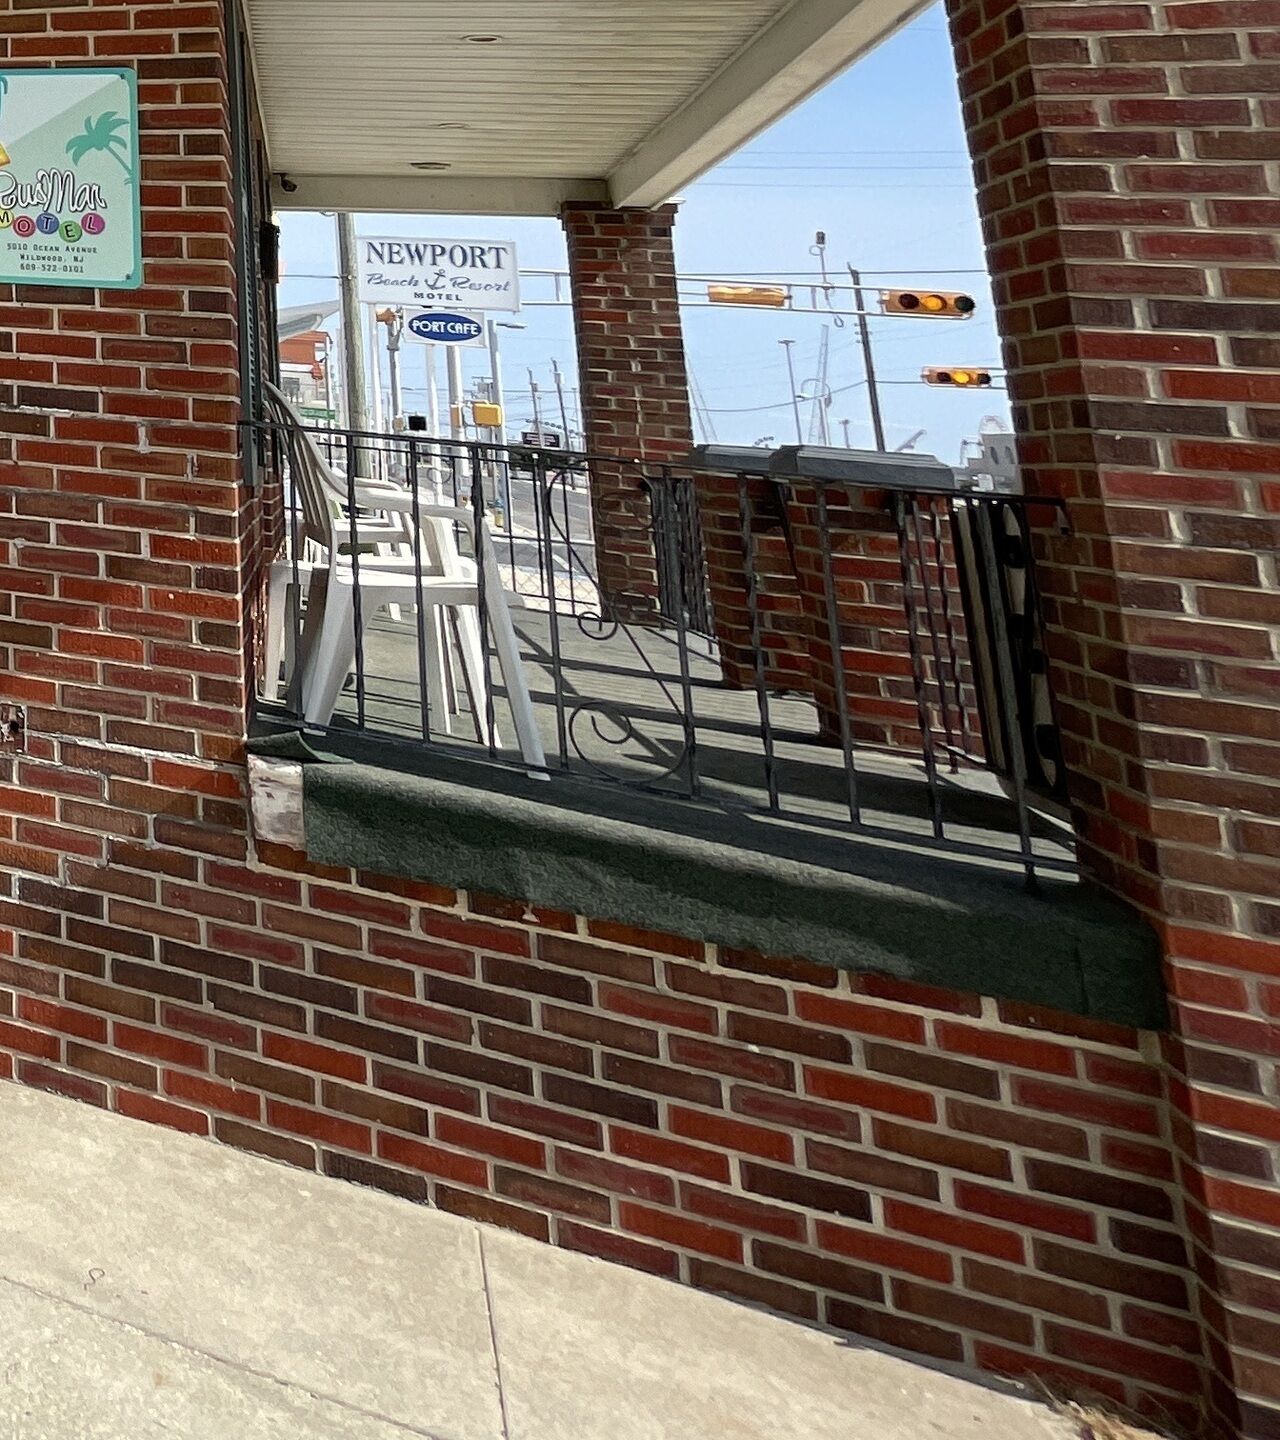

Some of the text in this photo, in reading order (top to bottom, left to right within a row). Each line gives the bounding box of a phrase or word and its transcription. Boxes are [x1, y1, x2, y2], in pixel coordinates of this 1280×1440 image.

[365, 241, 510, 269] NEWPORT
[366, 271, 511, 292] Beach Resort
[413, 292, 464, 302] MOTEL
[411, 319, 479, 336] PORT CAFE
